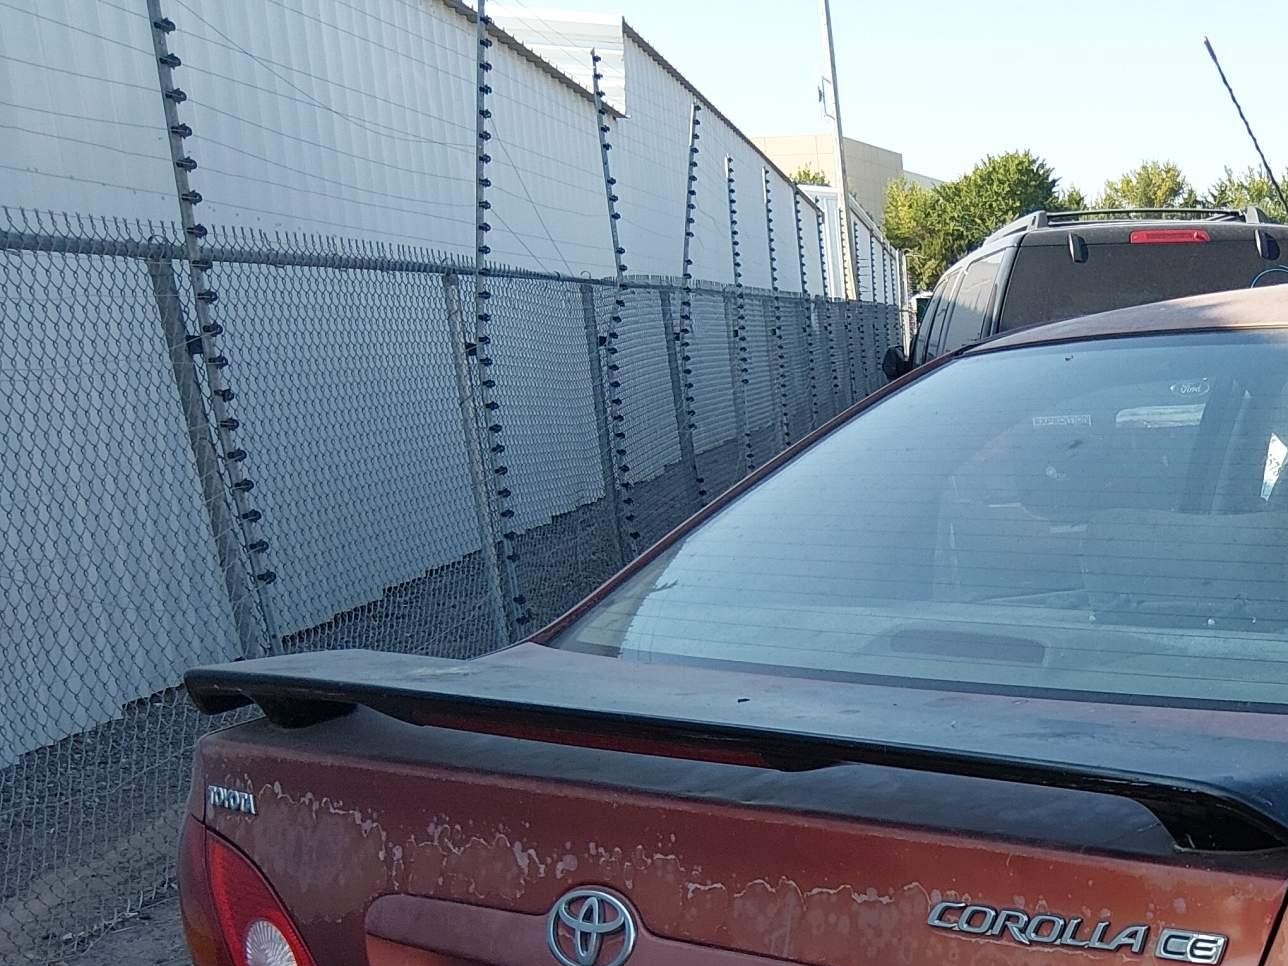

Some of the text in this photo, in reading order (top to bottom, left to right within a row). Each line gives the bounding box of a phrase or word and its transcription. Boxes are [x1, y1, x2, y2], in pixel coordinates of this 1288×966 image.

[208, 785, 256, 814] TOYOTA
[927, 901, 1223, 963] COROLLA CE
